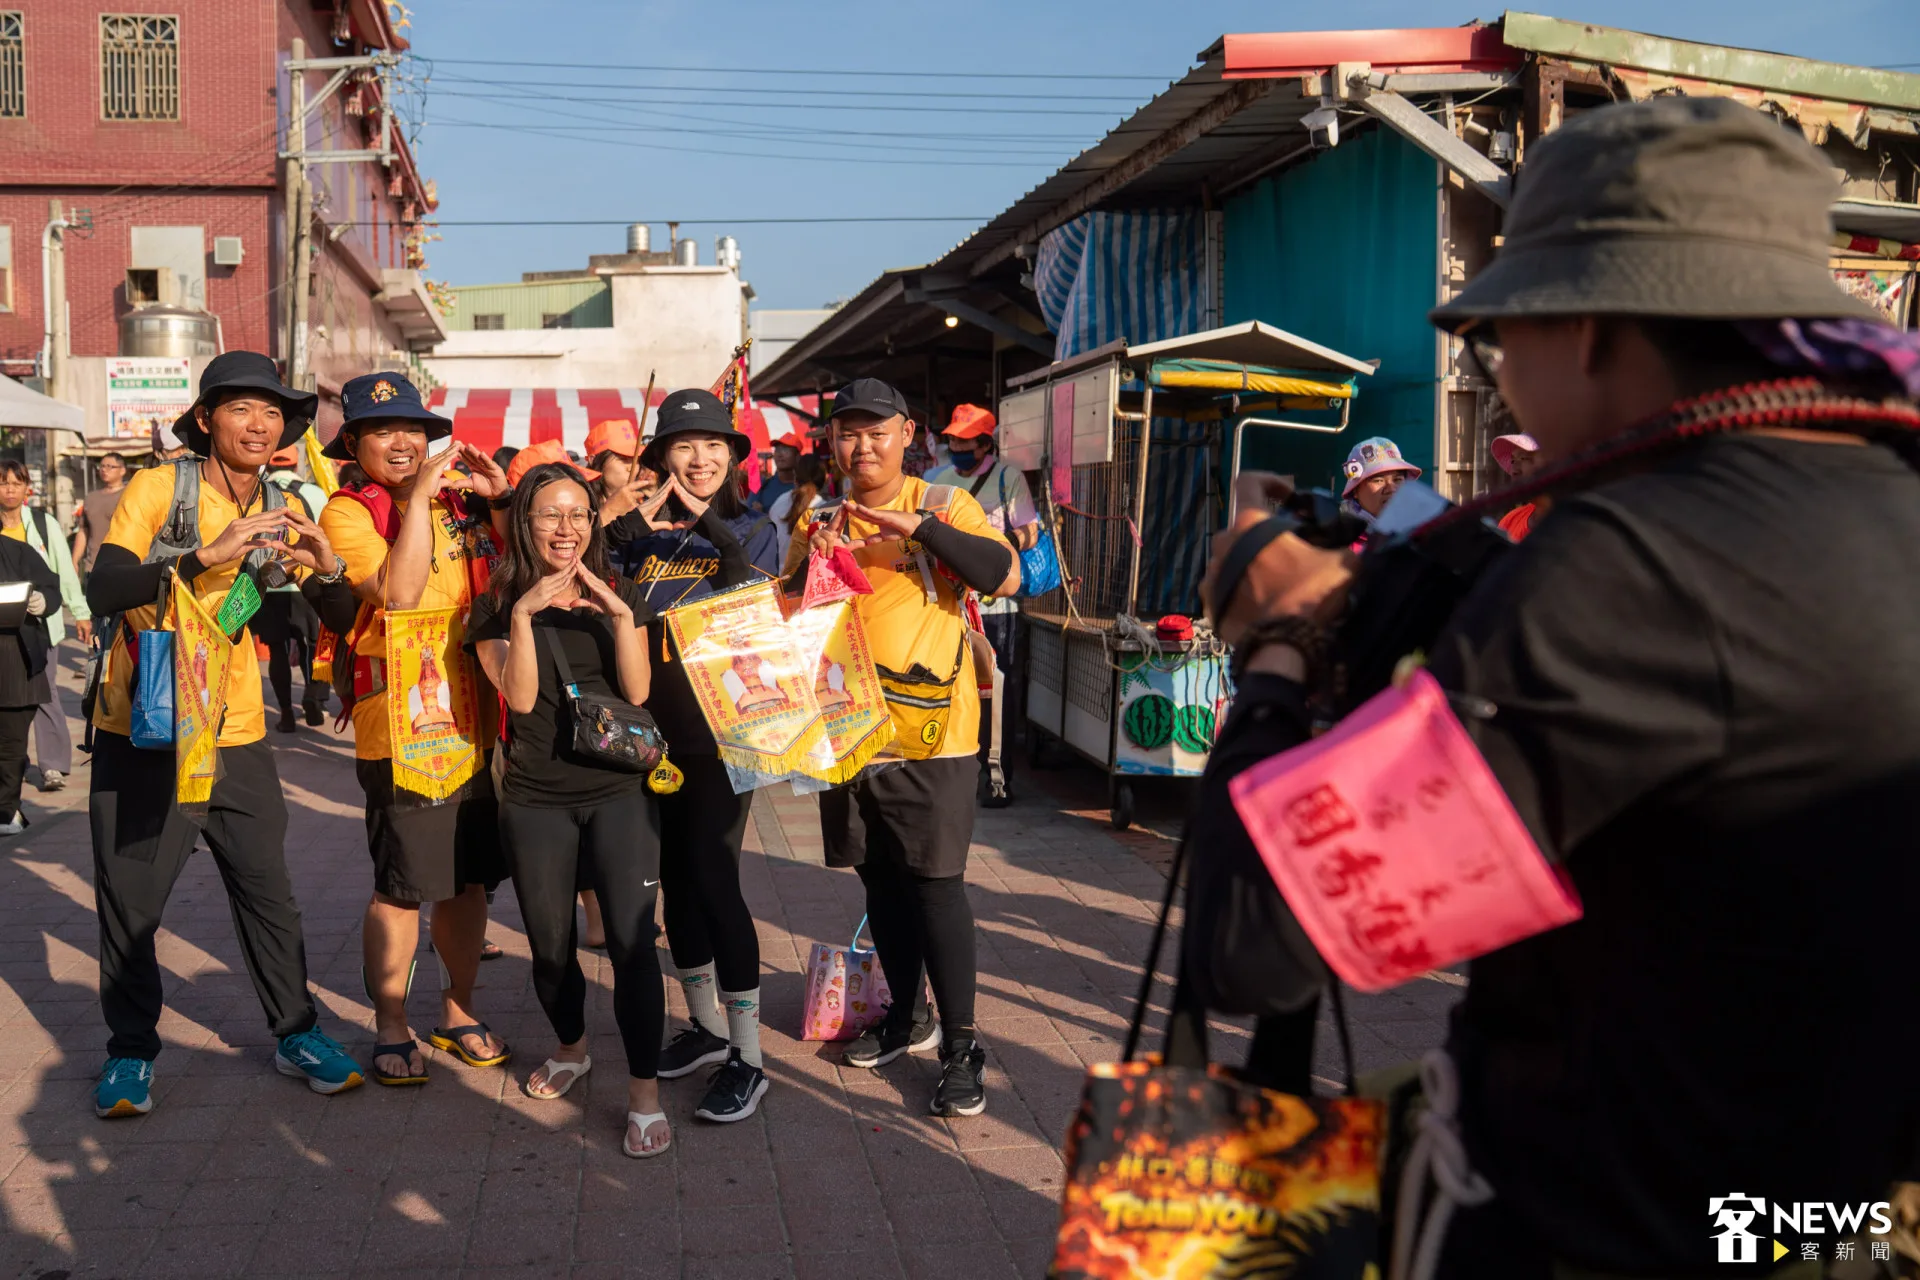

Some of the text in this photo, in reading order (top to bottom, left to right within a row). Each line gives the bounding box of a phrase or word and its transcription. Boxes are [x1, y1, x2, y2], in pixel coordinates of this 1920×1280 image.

[846, 622, 864, 674] 歲次丙午年
